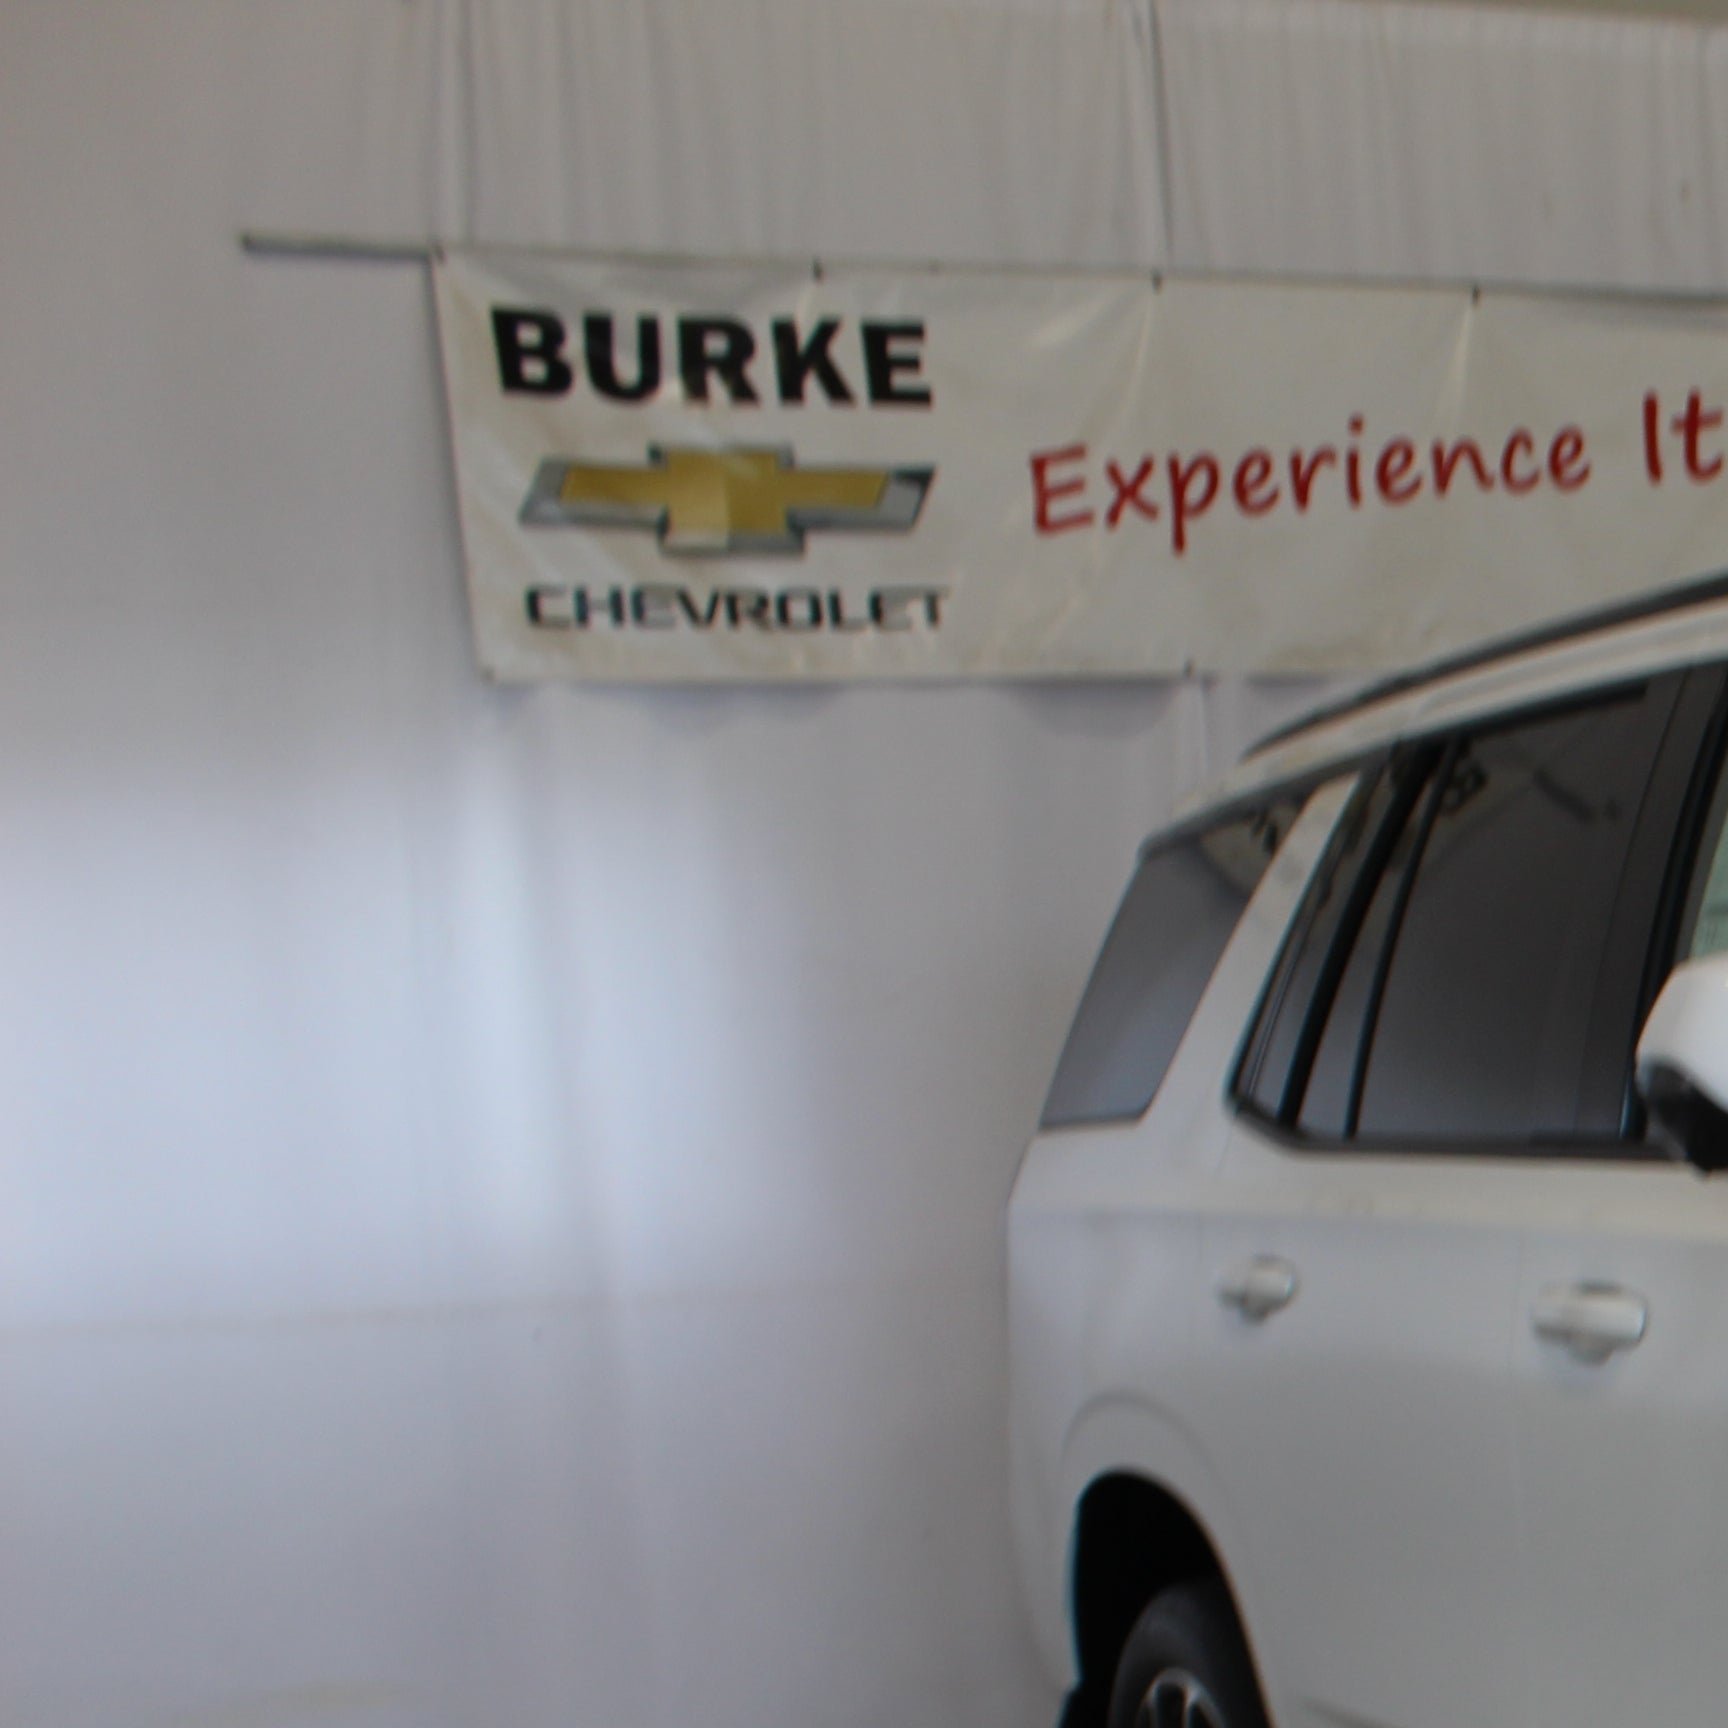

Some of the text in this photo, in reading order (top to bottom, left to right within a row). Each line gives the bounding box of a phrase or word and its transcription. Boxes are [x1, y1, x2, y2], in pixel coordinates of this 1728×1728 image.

[490, 307, 933, 408] BURKE
[1030, 414, 1593, 553] Experience
[524, 585, 947, 630] CHEVROLET
